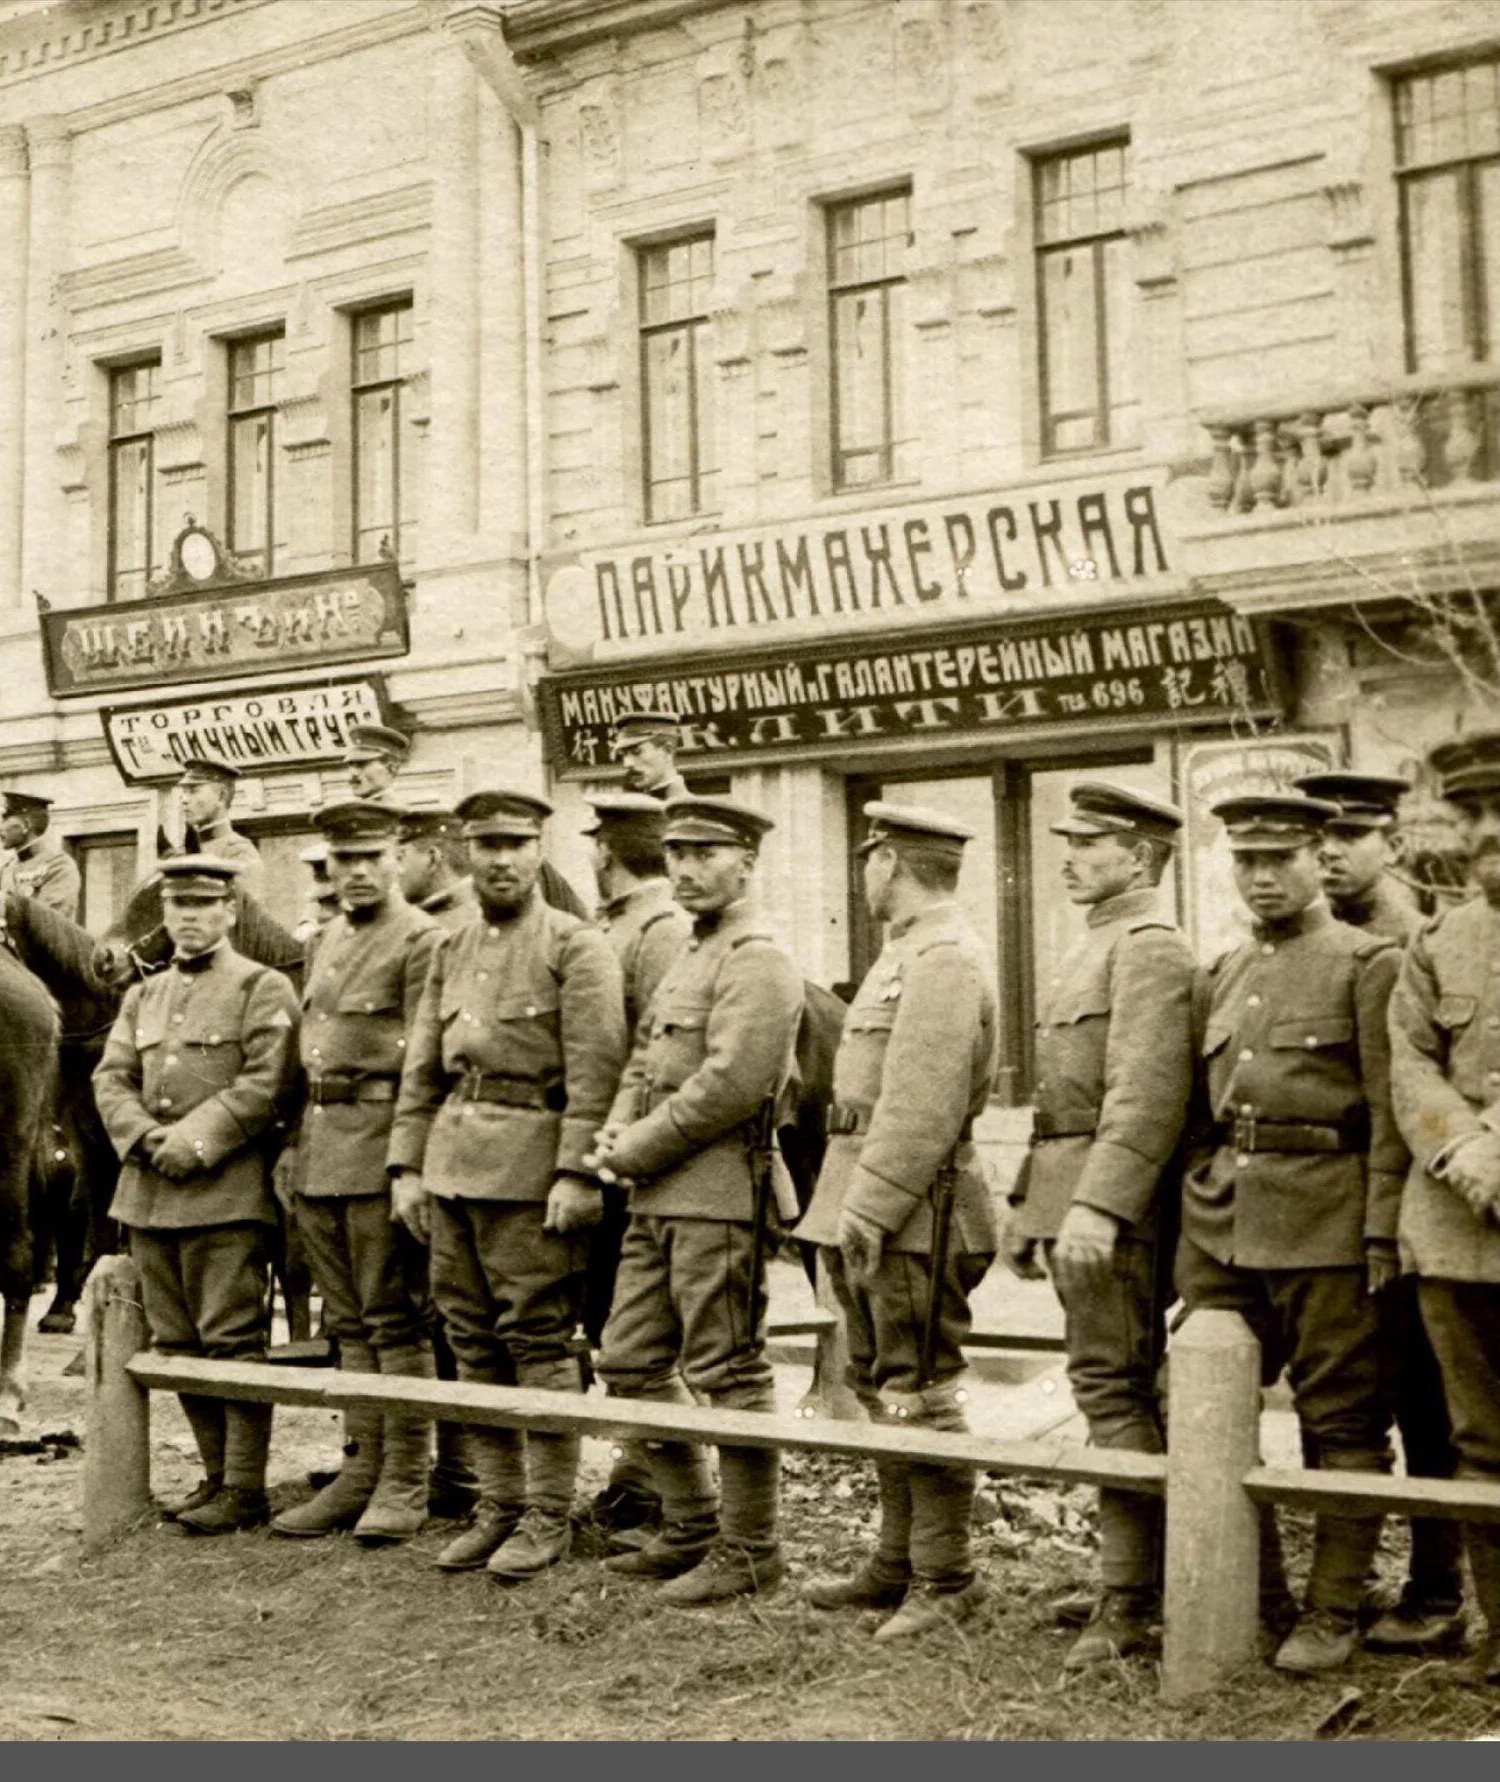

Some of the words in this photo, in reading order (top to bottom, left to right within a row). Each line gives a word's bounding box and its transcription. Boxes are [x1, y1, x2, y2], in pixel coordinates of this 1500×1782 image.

[595, 485, 1168, 641] ПАРИКМАХЕРСКАЯ
[121, 689, 362, 734] ТОРГОВЛЯ
[561, 662, 806, 728] МАНУФАКТУРНЫЙ
[816, 626, 1095, 702] ГАЛАНТЕРЕЙНЫЙ
[749, 687, 1048, 744] ЛИТИ
[1091, 677, 1145, 709] 696
